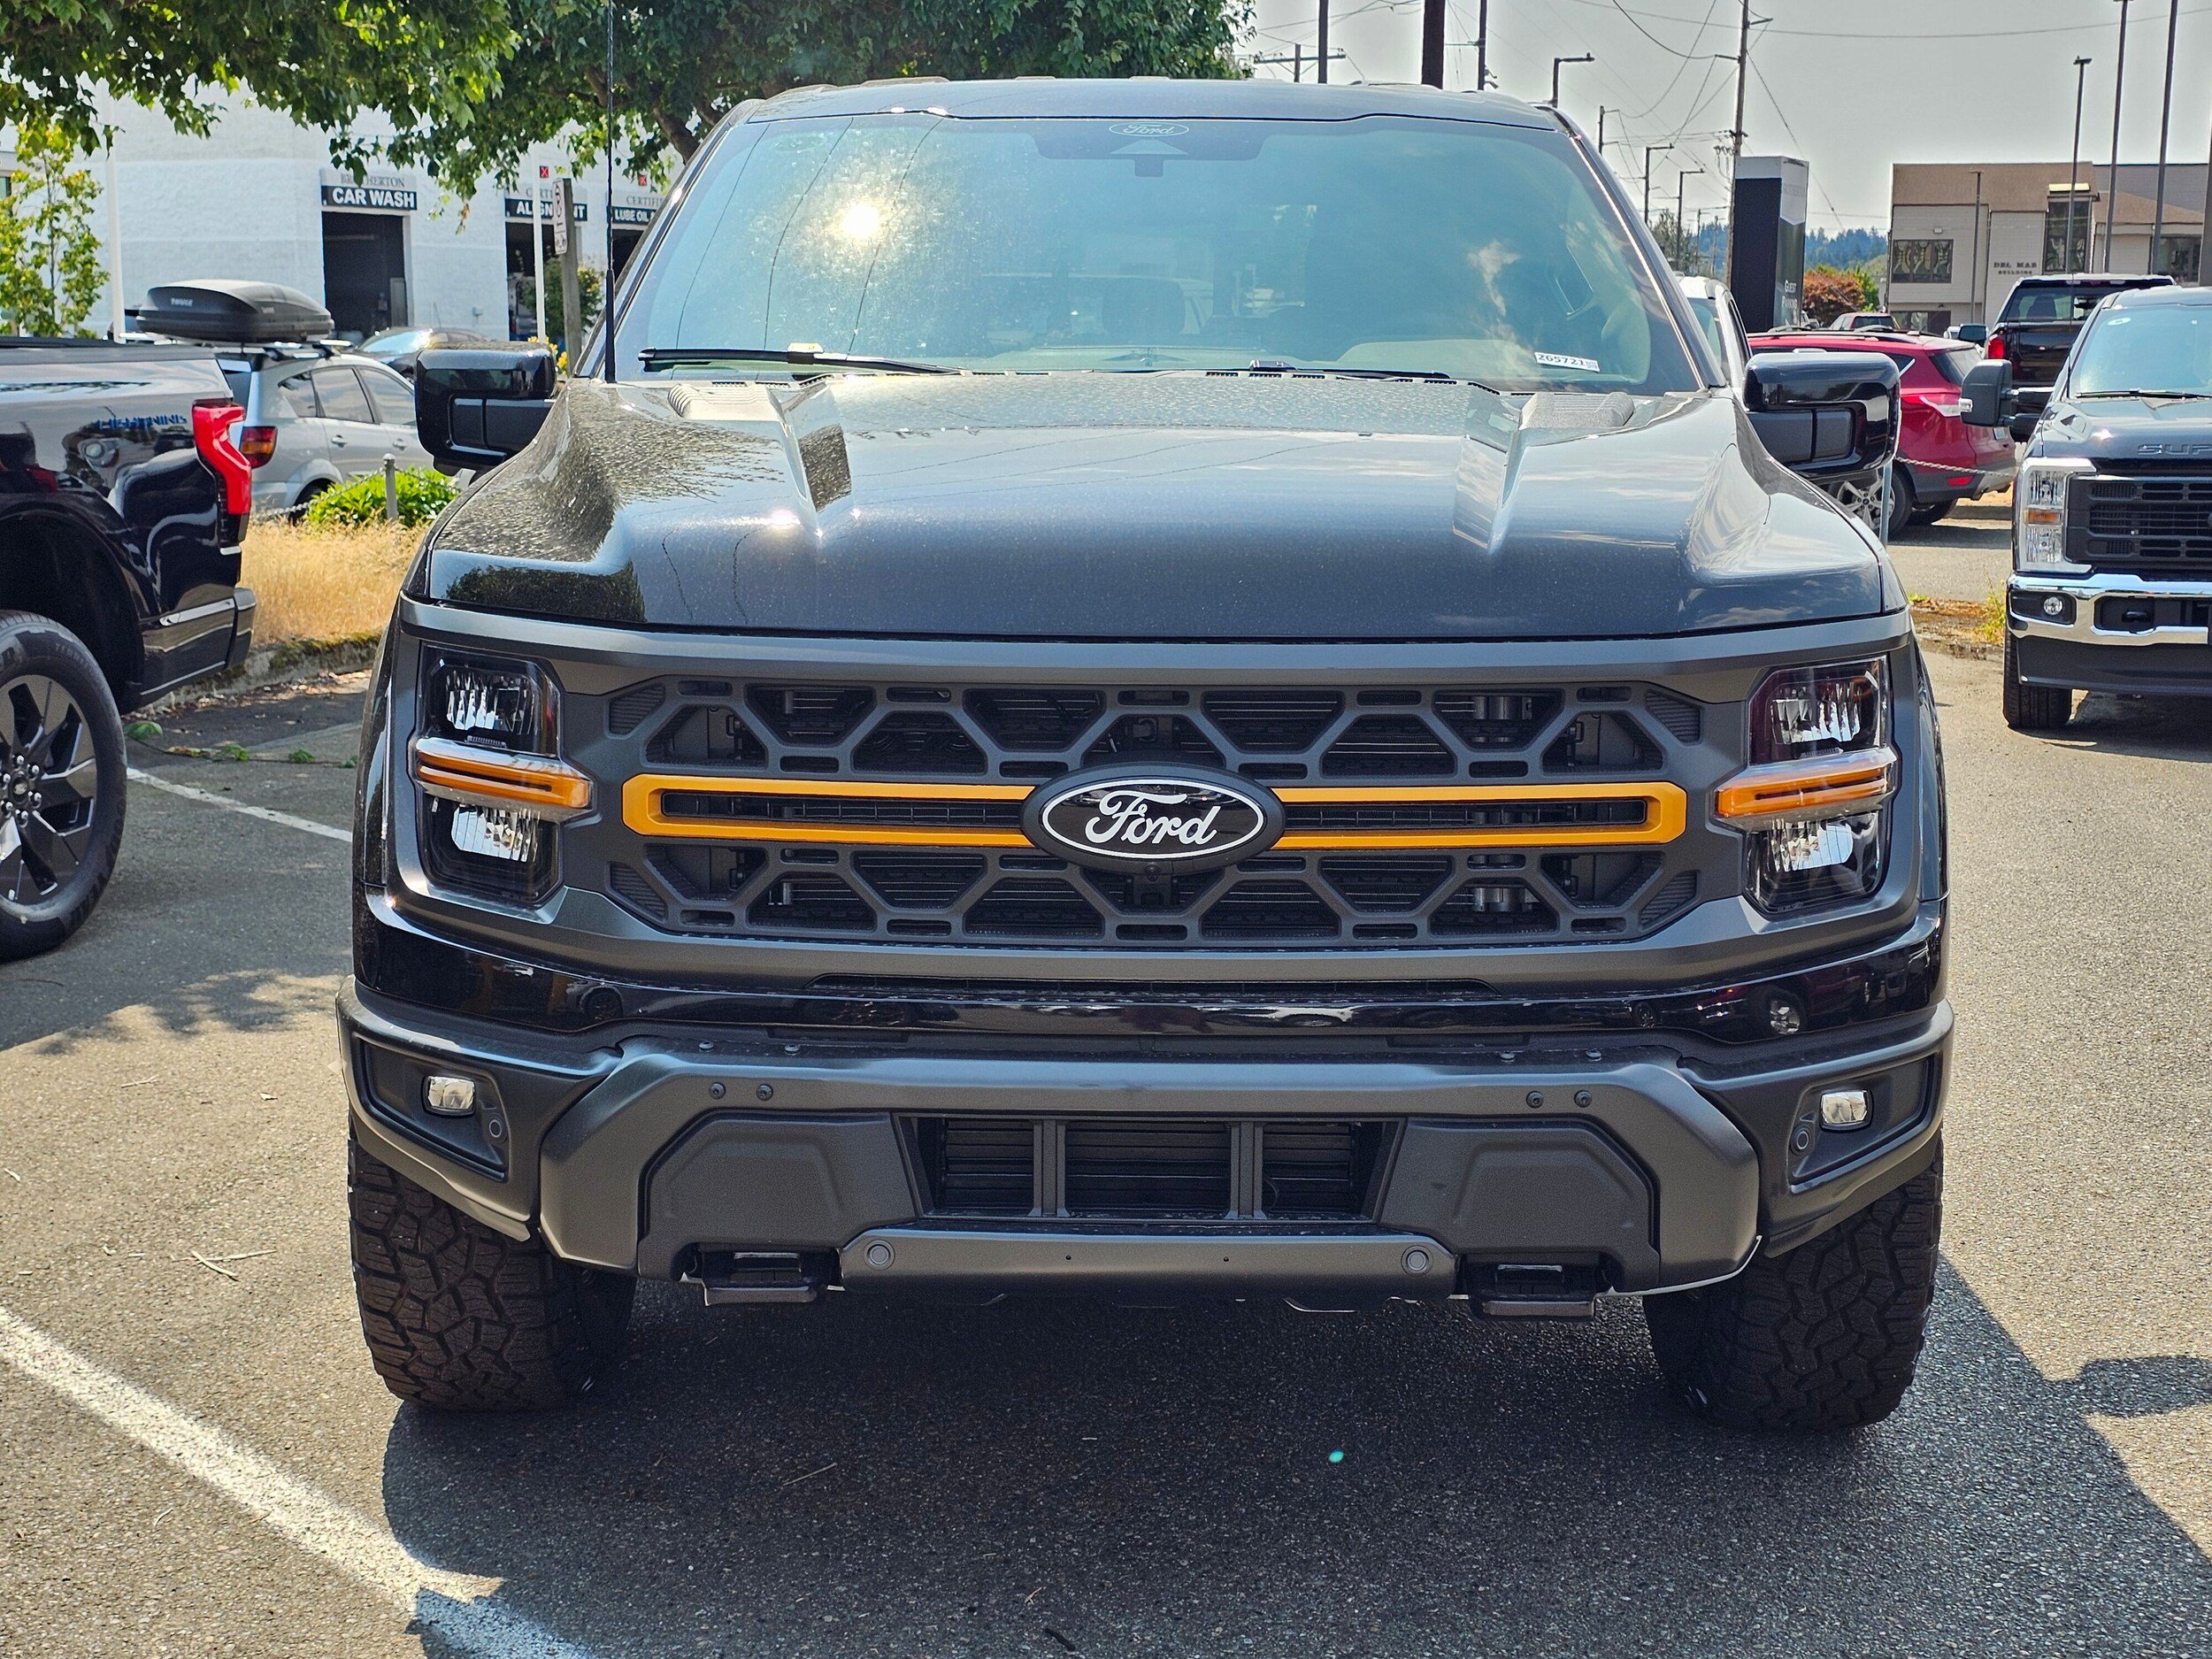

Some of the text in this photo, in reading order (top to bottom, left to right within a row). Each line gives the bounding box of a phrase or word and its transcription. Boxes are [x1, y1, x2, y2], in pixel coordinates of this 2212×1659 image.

[1123, 124, 1175, 134] Ford
[333, 188, 415, 208] CAR WASH
[615, 210, 635, 221] LUBE
[637, 211, 649, 222] OIL
[1085, 790, 1221, 845] Ford
